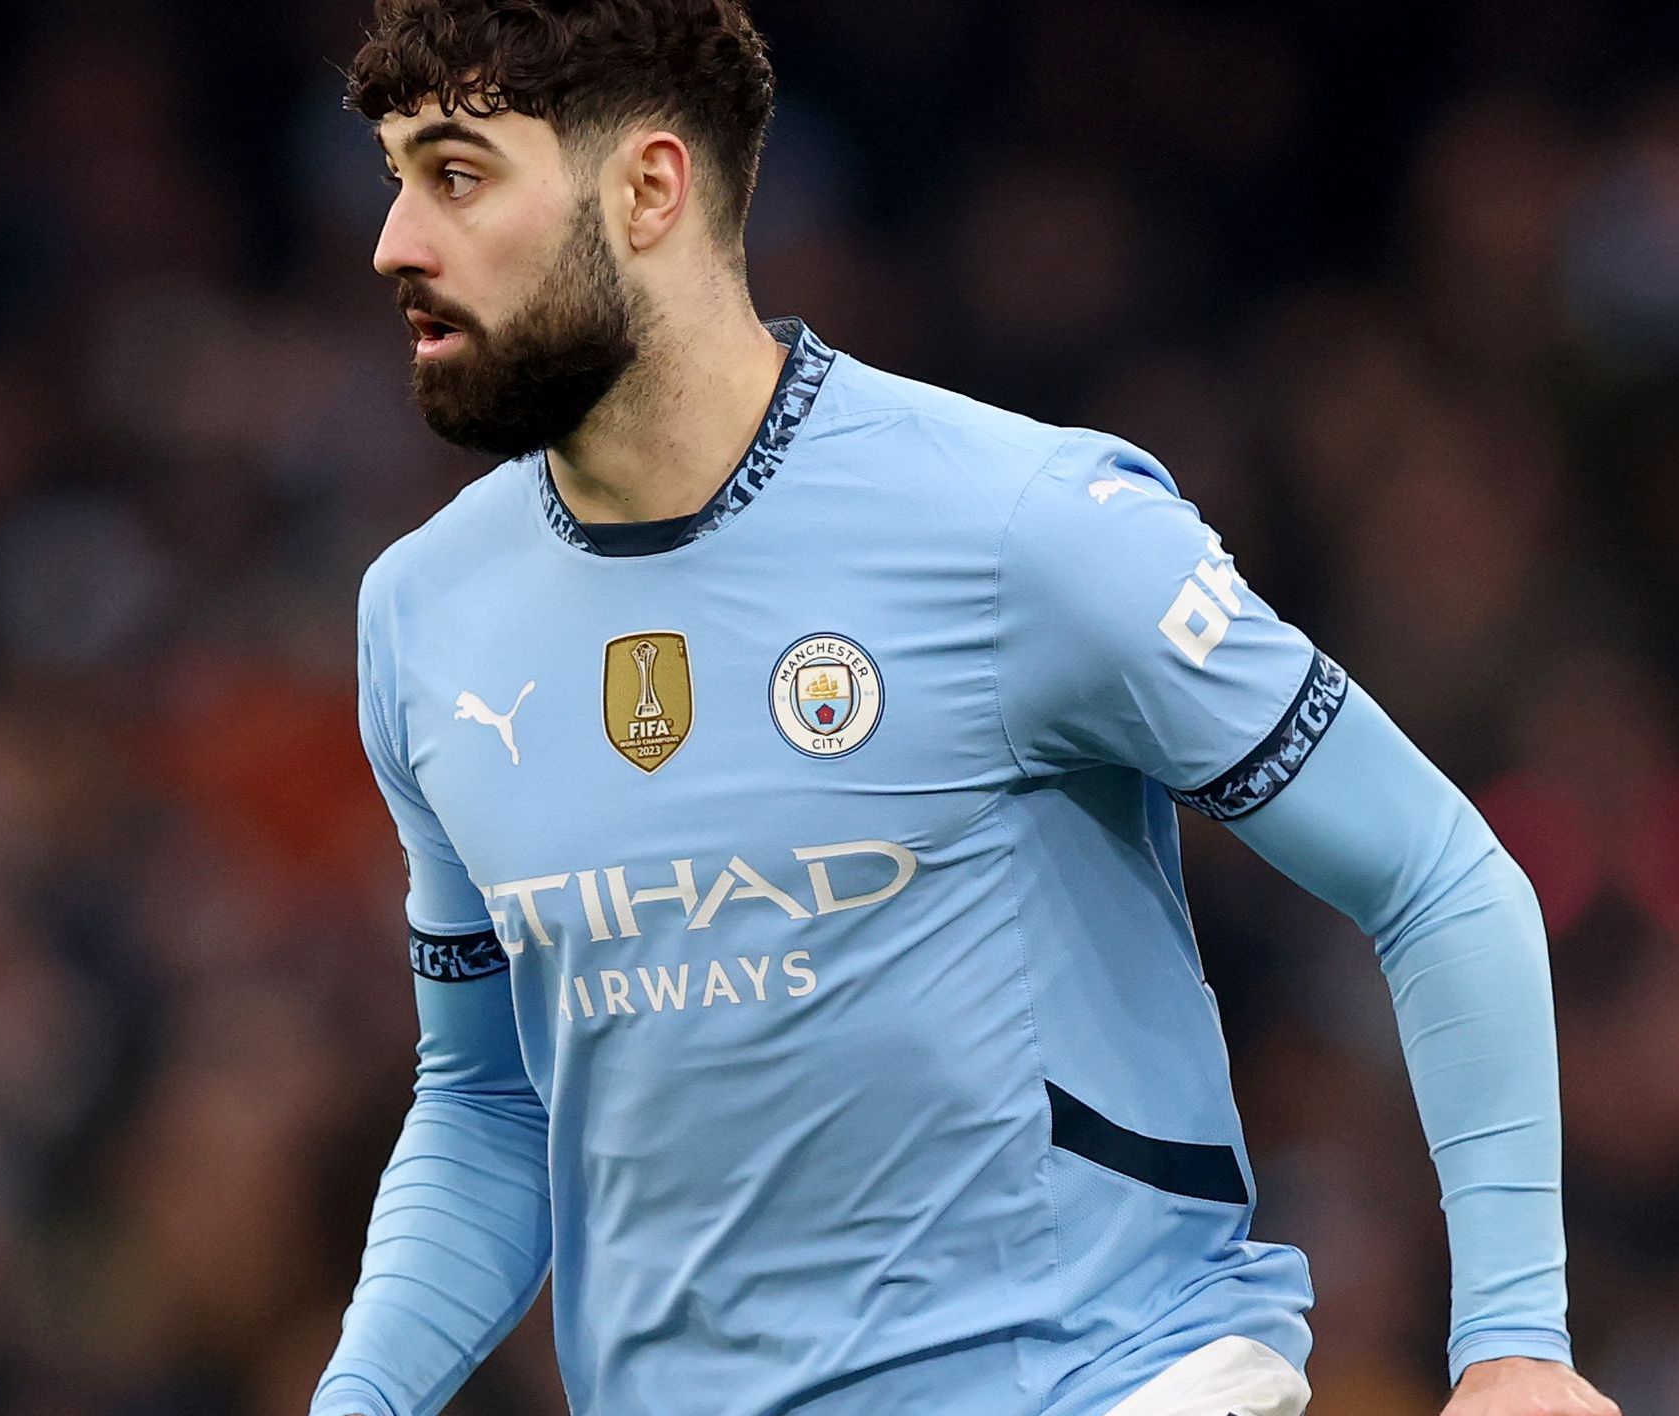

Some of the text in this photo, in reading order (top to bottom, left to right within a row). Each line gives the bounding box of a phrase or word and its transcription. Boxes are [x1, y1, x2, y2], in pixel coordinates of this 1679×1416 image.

[780, 643, 868, 682] MANCHESTER
[629, 719, 670, 739] FIFA
[637, 745, 661, 757] 2023
[812, 738, 844, 750] CITY
